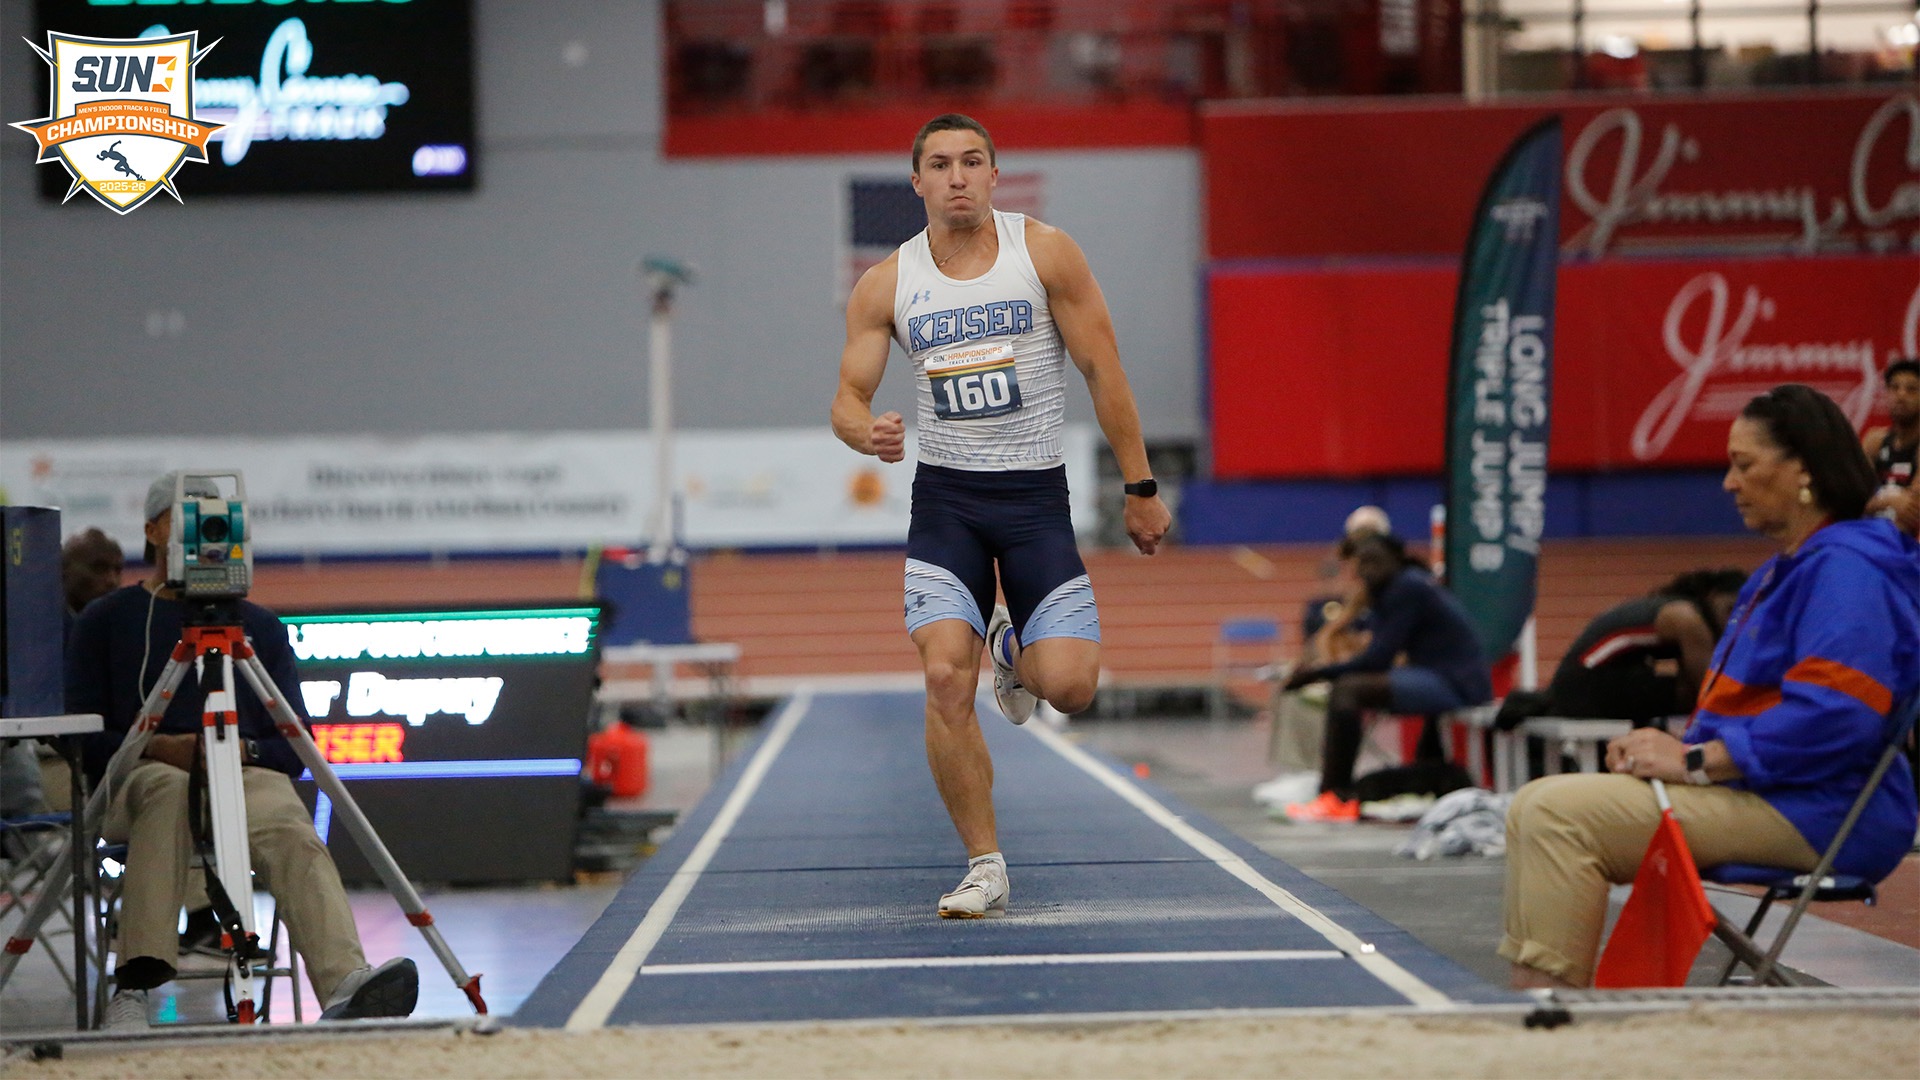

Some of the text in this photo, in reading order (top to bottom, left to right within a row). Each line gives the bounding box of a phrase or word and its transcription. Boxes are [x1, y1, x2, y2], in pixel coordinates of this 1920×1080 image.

[908, 299, 1034, 352] KEISER
[1474, 297, 1510, 427] TRIPLE
[1508, 314, 1547, 429] LONG
[943, 371, 1011, 413] 160
[1470, 429, 1505, 540] JUMP
